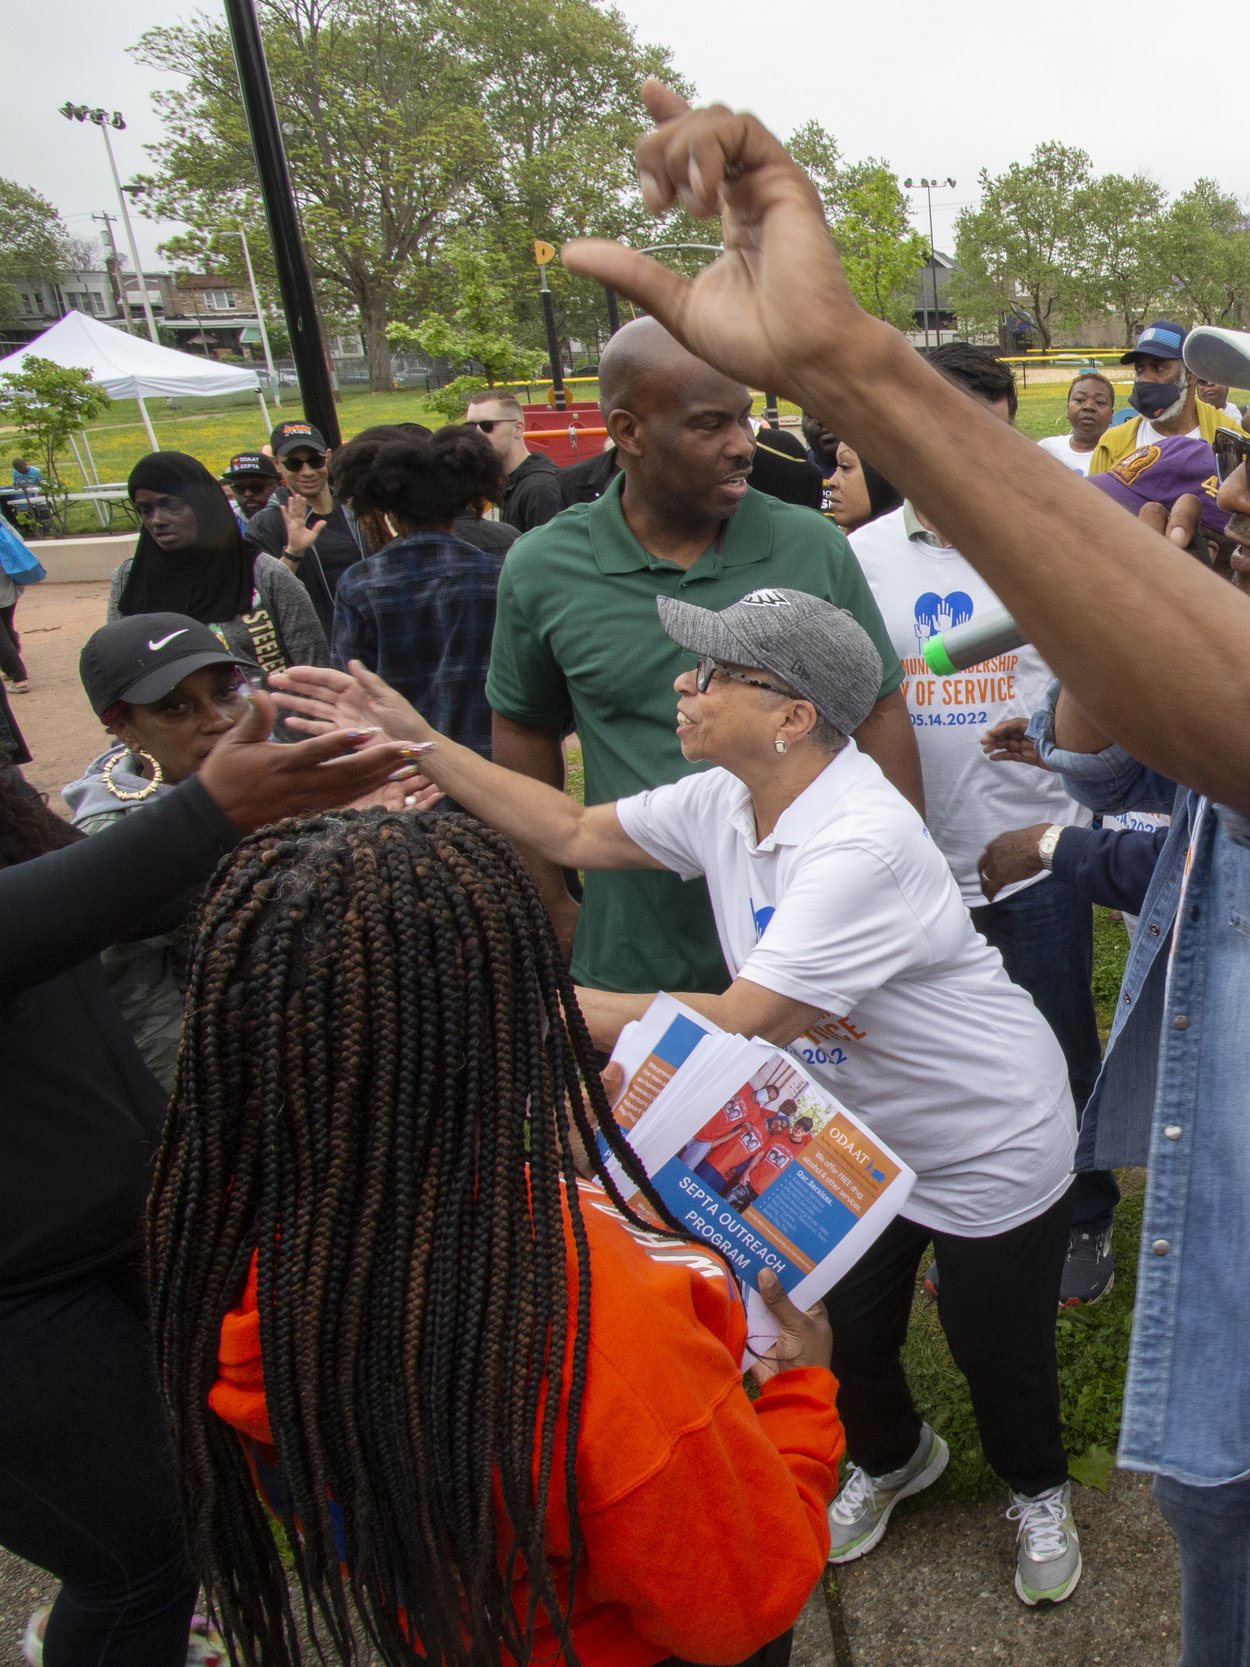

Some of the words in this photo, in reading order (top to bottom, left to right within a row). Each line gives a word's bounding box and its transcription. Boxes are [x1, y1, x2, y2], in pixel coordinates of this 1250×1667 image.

[915, 680, 936, 707] OF
[942, 675, 1016, 706] SERVICE
[910, 710, 988, 727] 05.14.2022
[829, 1127, 870, 1166] ODAAT
[797, 1170, 810, 1183] Our
[802, 1155, 824, 1175] alcohol
[820, 1170, 827, 1180] &
[825, 1175, 842, 1192] other
[815, 1151, 826, 1163] We
[824, 1159, 841, 1176] offer
[837, 1172, 853, 1188] FREE
[679, 1176, 719, 1216] SEPTA
[718, 1212, 786, 1273] OUTREACH
[684, 1210, 751, 1269] PROGRAM
